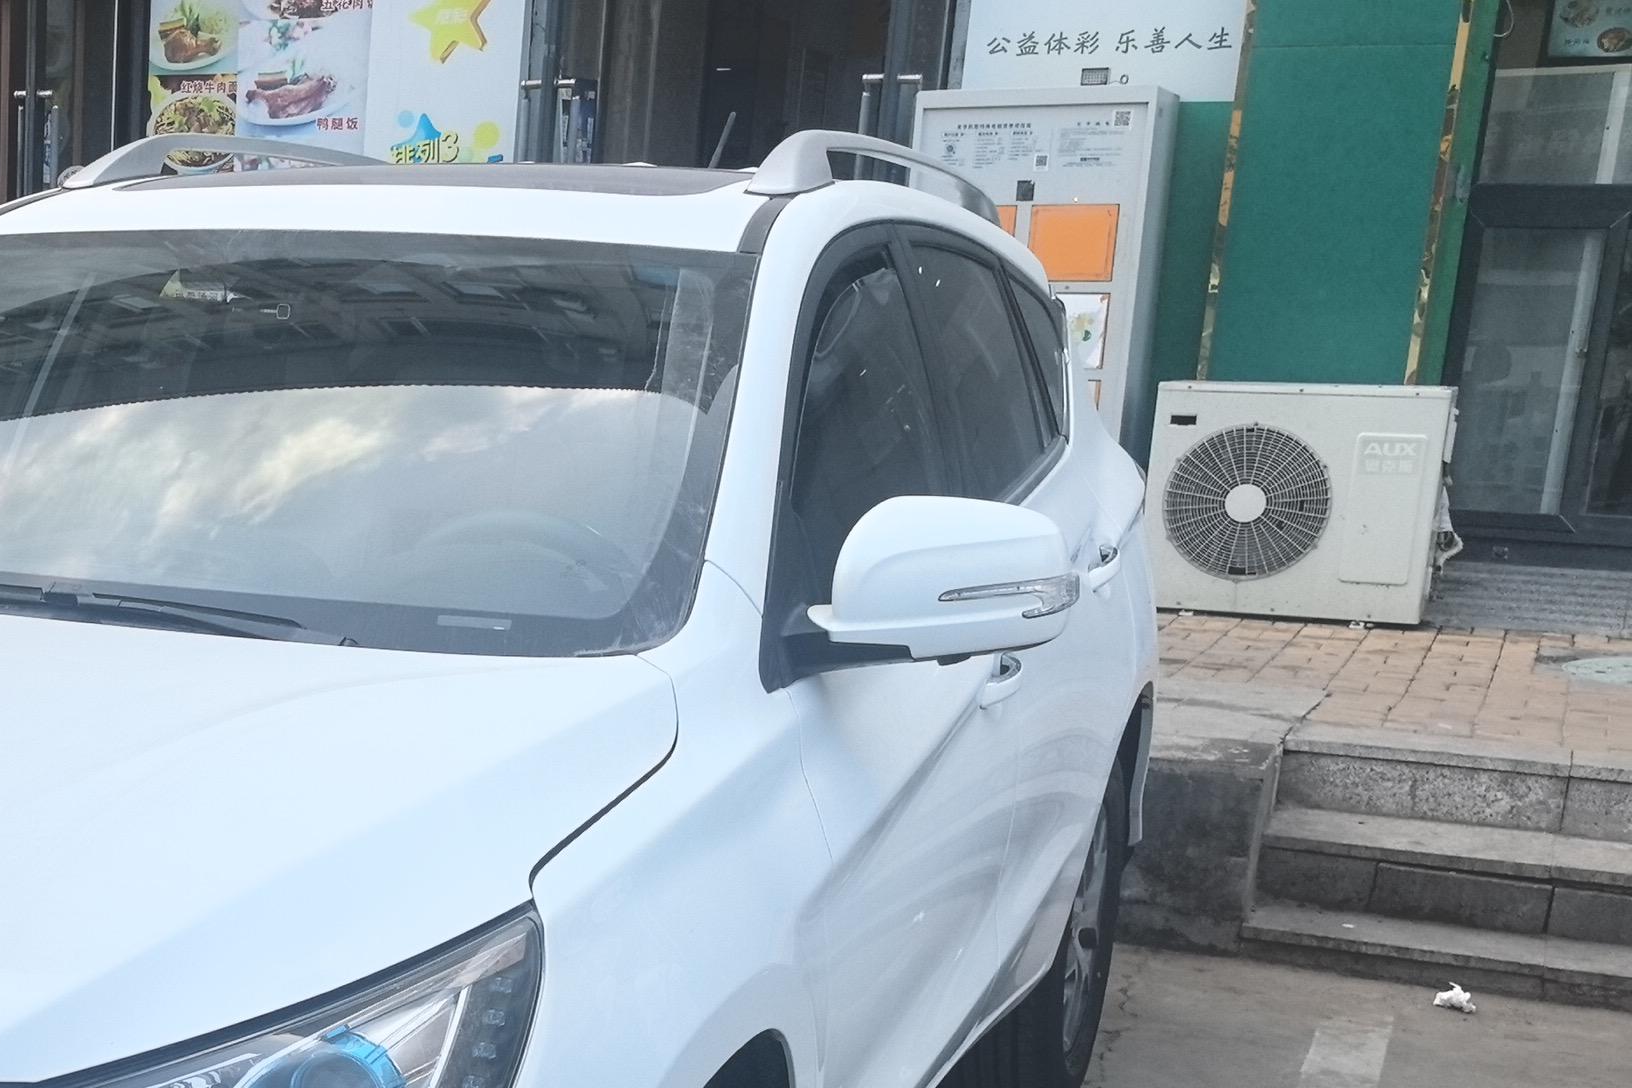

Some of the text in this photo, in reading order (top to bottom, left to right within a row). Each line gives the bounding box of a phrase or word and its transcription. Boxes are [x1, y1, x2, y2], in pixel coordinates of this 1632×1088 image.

[986, 26, 1233, 56] 公益体彩 乐善人生
[316, 117, 358, 131] 鸭腿饭
[1364, 442, 1417, 456] AUX
